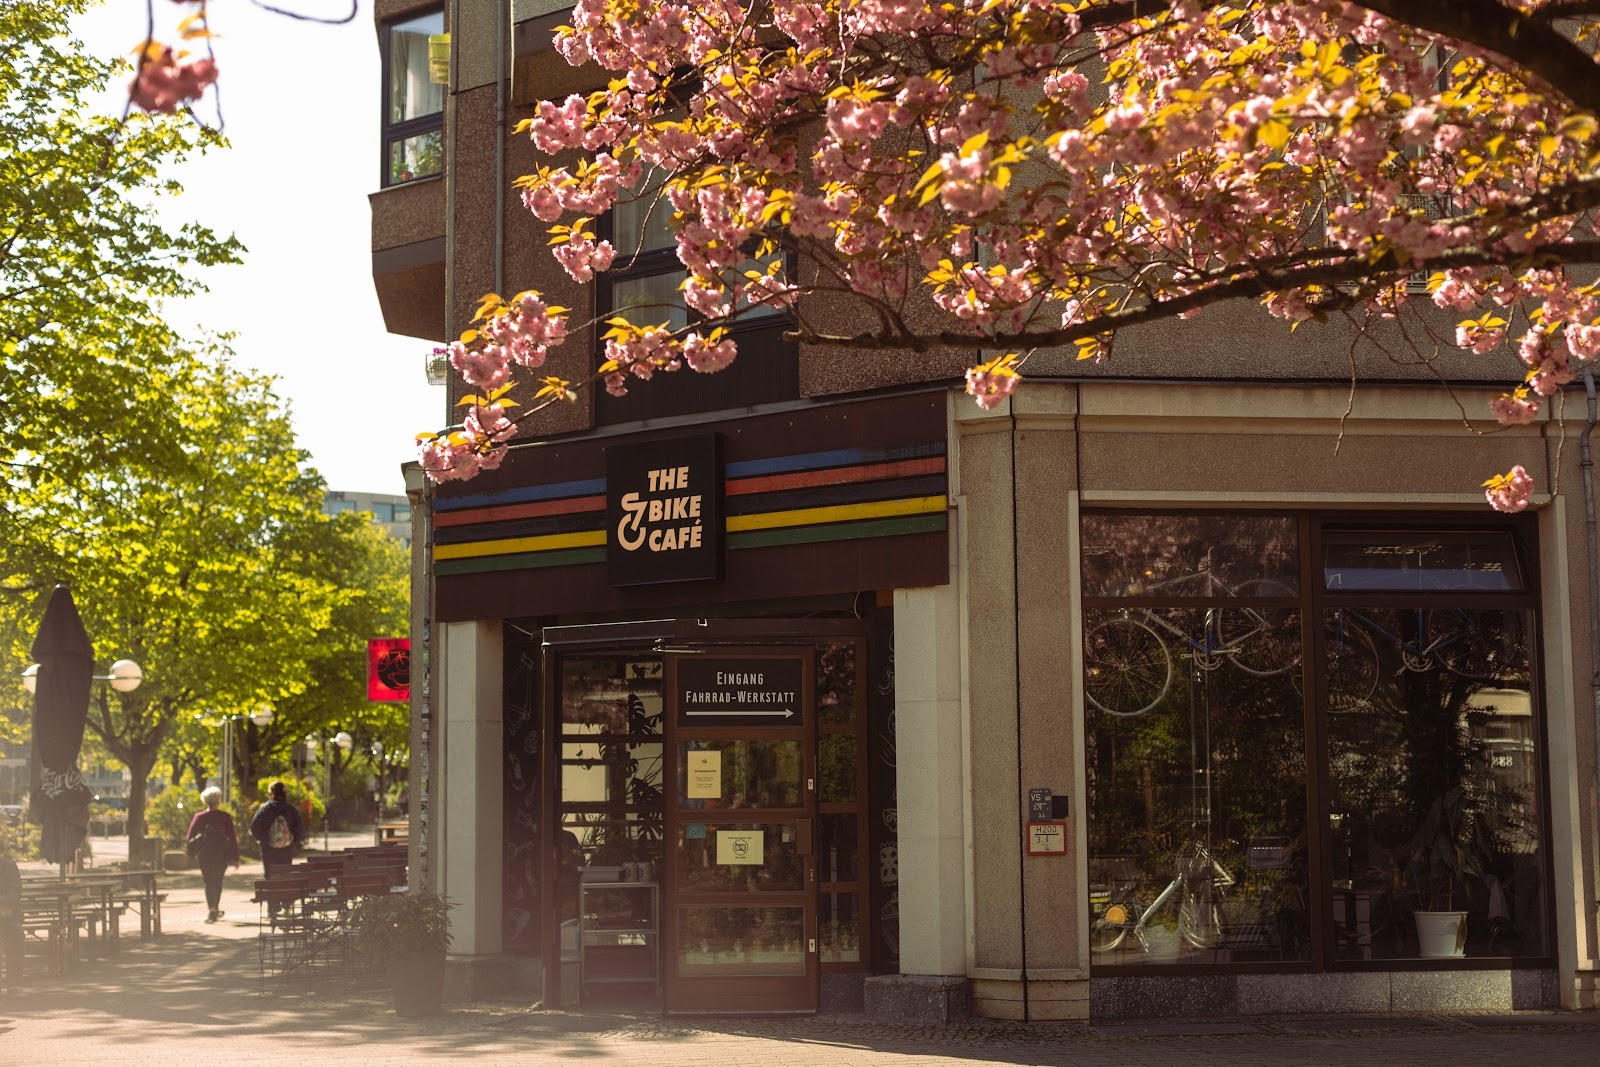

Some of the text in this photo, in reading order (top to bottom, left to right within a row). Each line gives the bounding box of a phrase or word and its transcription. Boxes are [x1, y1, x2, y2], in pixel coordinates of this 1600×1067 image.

[648, 466, 689, 492] THE
[648, 495, 702, 522] BIKE
[648, 518, 703, 552] CAFÉ
[716, 671, 764, 685] EINGANG
[685, 690, 795, 703] FAHRRAD-WERKSTATT
